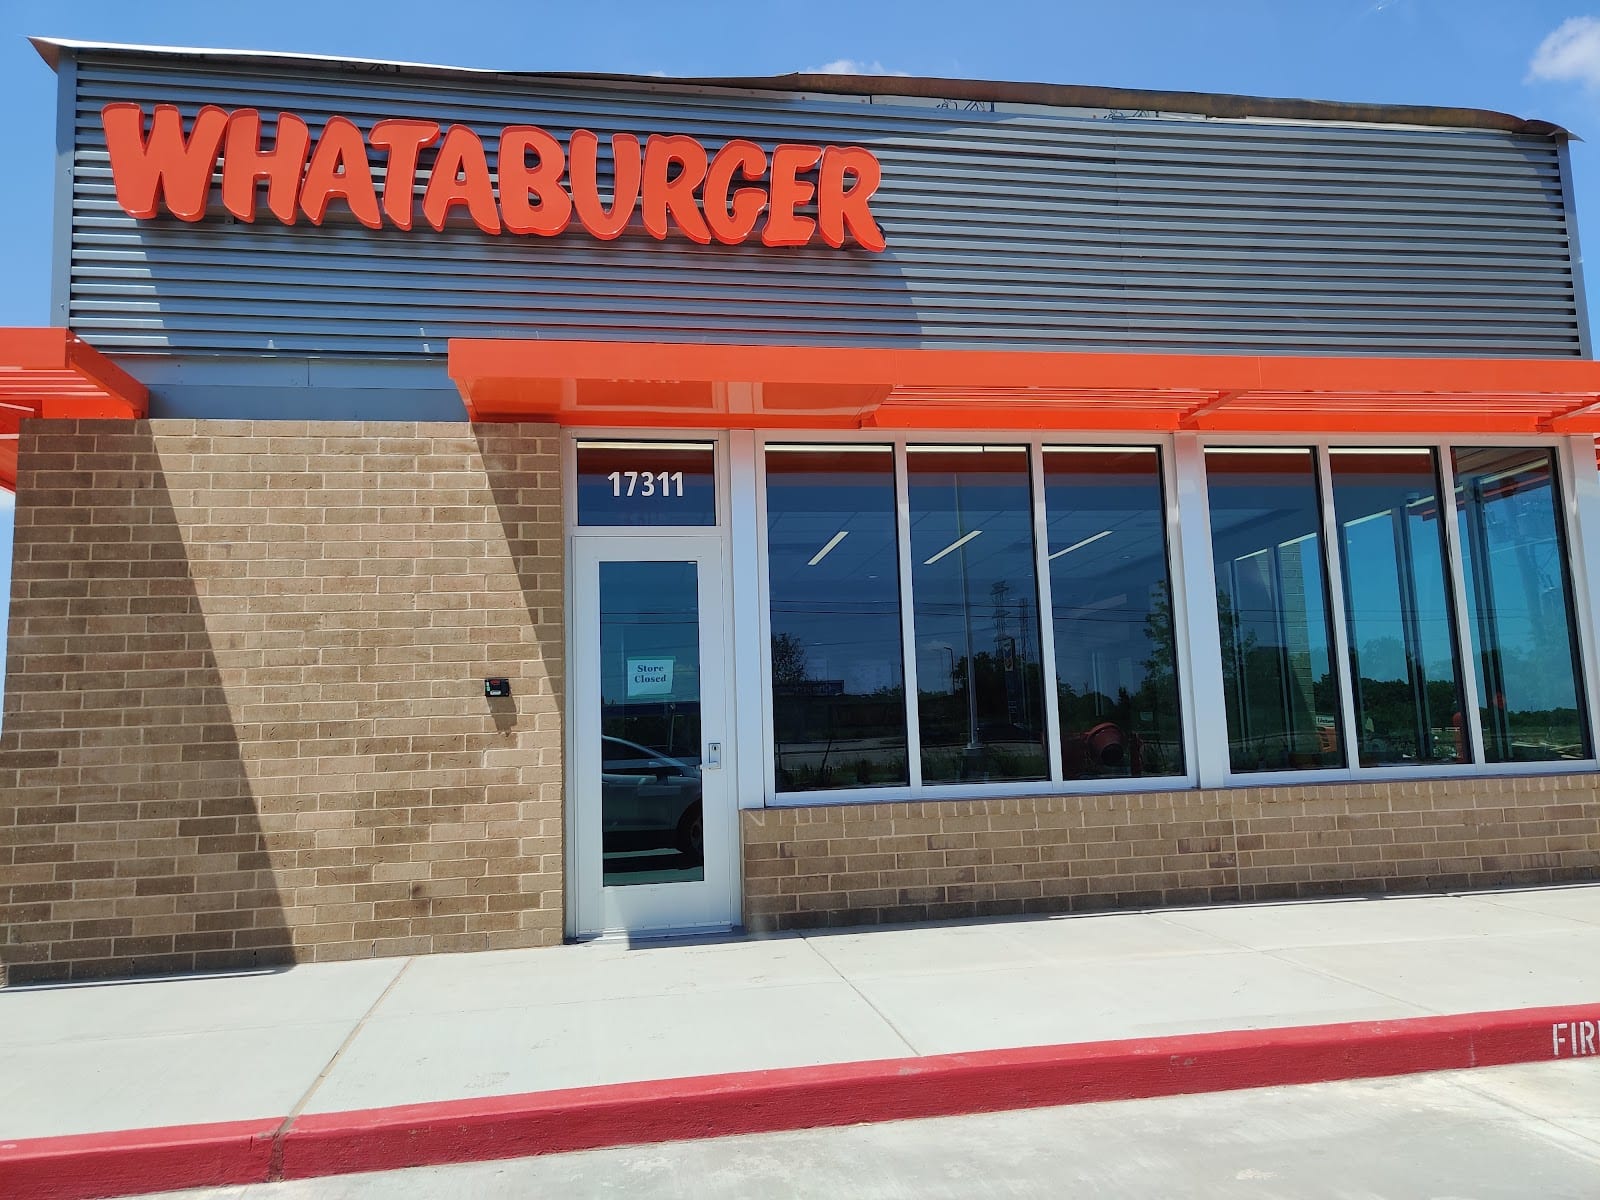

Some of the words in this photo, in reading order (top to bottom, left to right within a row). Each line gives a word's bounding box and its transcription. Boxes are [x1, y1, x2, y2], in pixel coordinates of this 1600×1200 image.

[101, 102, 887, 252] WHATABURGER
[608, 471, 684, 497] 17311
[634, 674, 667, 683] Closed
[637, 664, 665, 673] Store
[1552, 1020, 1600, 1056] FIR
